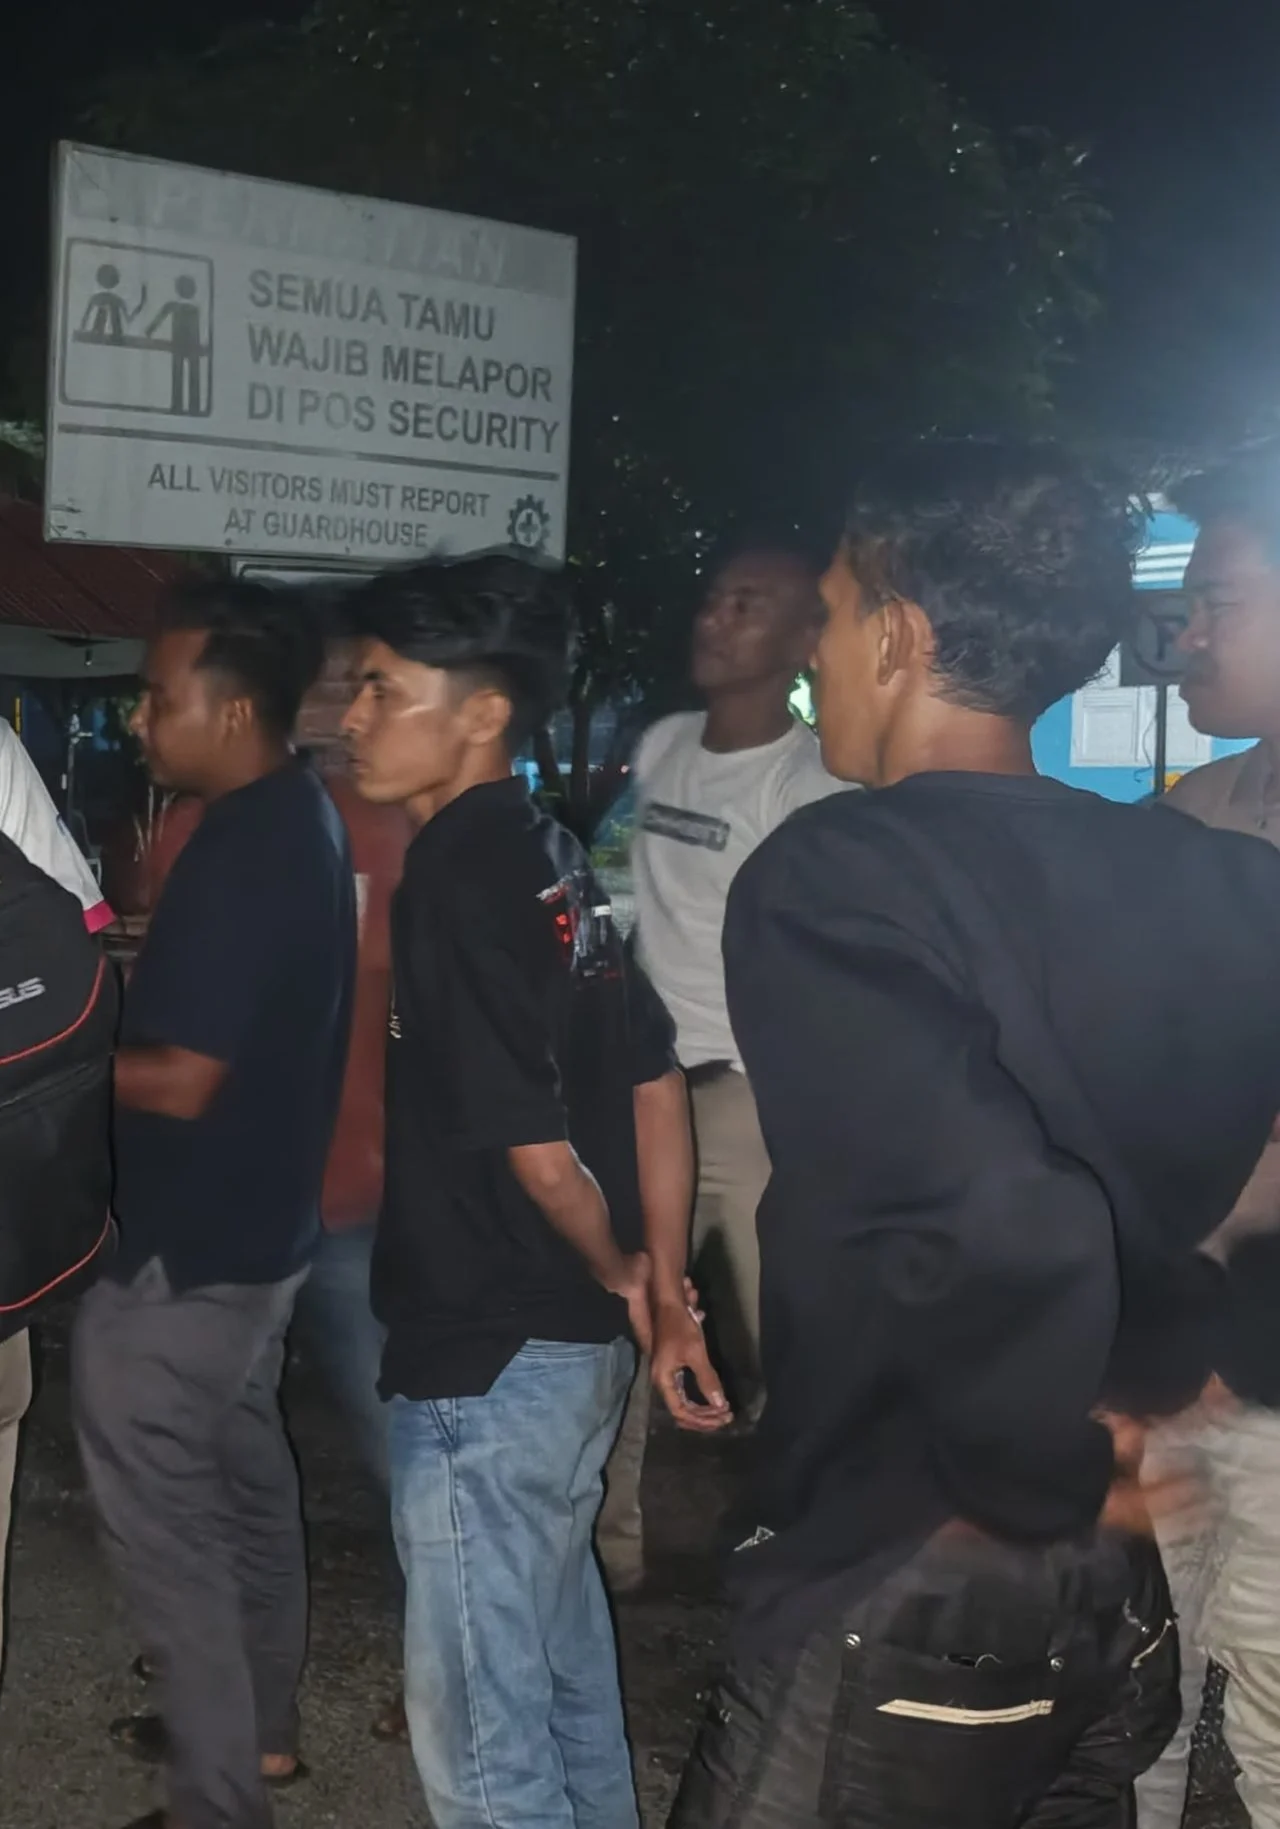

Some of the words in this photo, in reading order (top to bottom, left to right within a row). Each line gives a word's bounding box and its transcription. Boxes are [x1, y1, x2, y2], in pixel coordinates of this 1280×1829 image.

[248, 268, 387, 325] SEMUA
[397, 293, 495, 341] TAMU
[247, 323, 369, 376] WAJIB
[382, 344, 553, 402] MELAPOR
[247, 383, 285, 422] DI
[298, 392, 375, 433] POS
[388, 402, 560, 454] SECURITY
[148, 463, 200, 494] ALL
[209, 465, 321, 502] VISITORS
[329, 477, 395, 510] MUST
[402, 486, 490, 518] REPORT
[224, 509, 256, 534] AT
[263, 511, 428, 548] GUARDHOUSE
